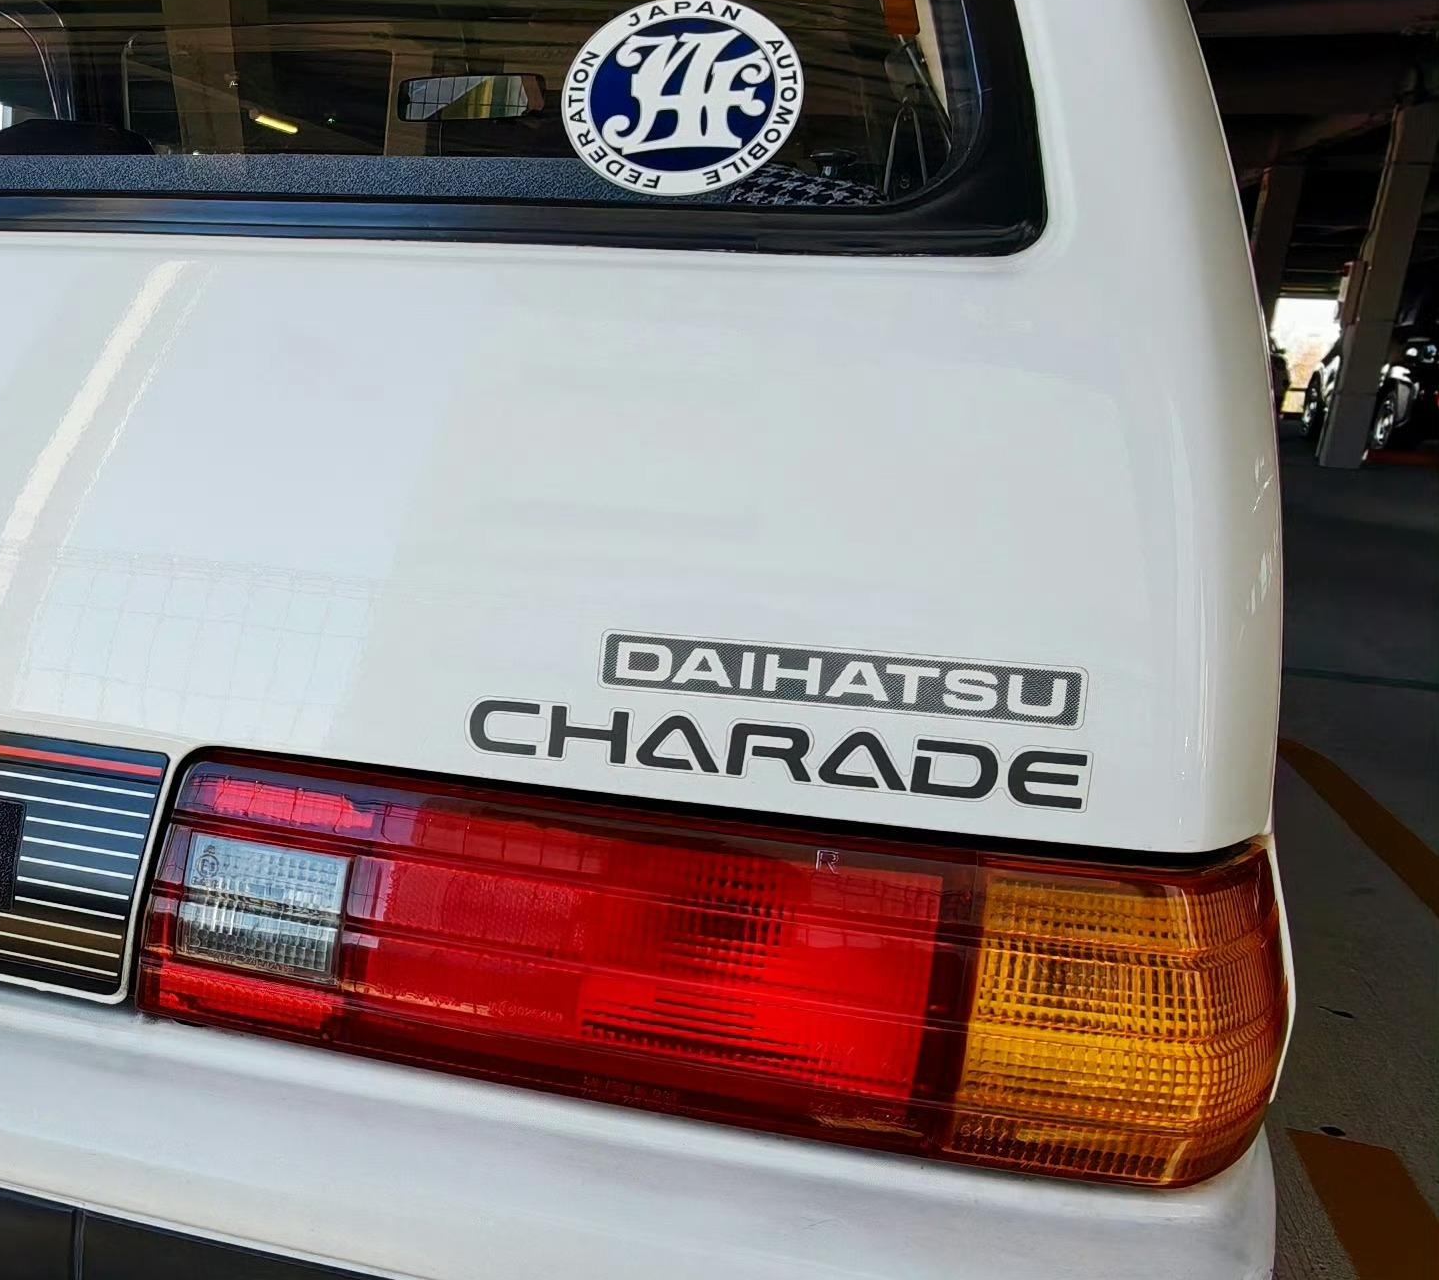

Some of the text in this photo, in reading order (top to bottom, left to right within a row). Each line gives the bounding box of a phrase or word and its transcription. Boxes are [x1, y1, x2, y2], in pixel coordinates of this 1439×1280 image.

[568, 0, 798, 191] JAPAN AUTOMOBILE FEDERATION
[615, 640, 1067, 717] DAIHATSU
[469, 700, 1089, 811] CHARADE
